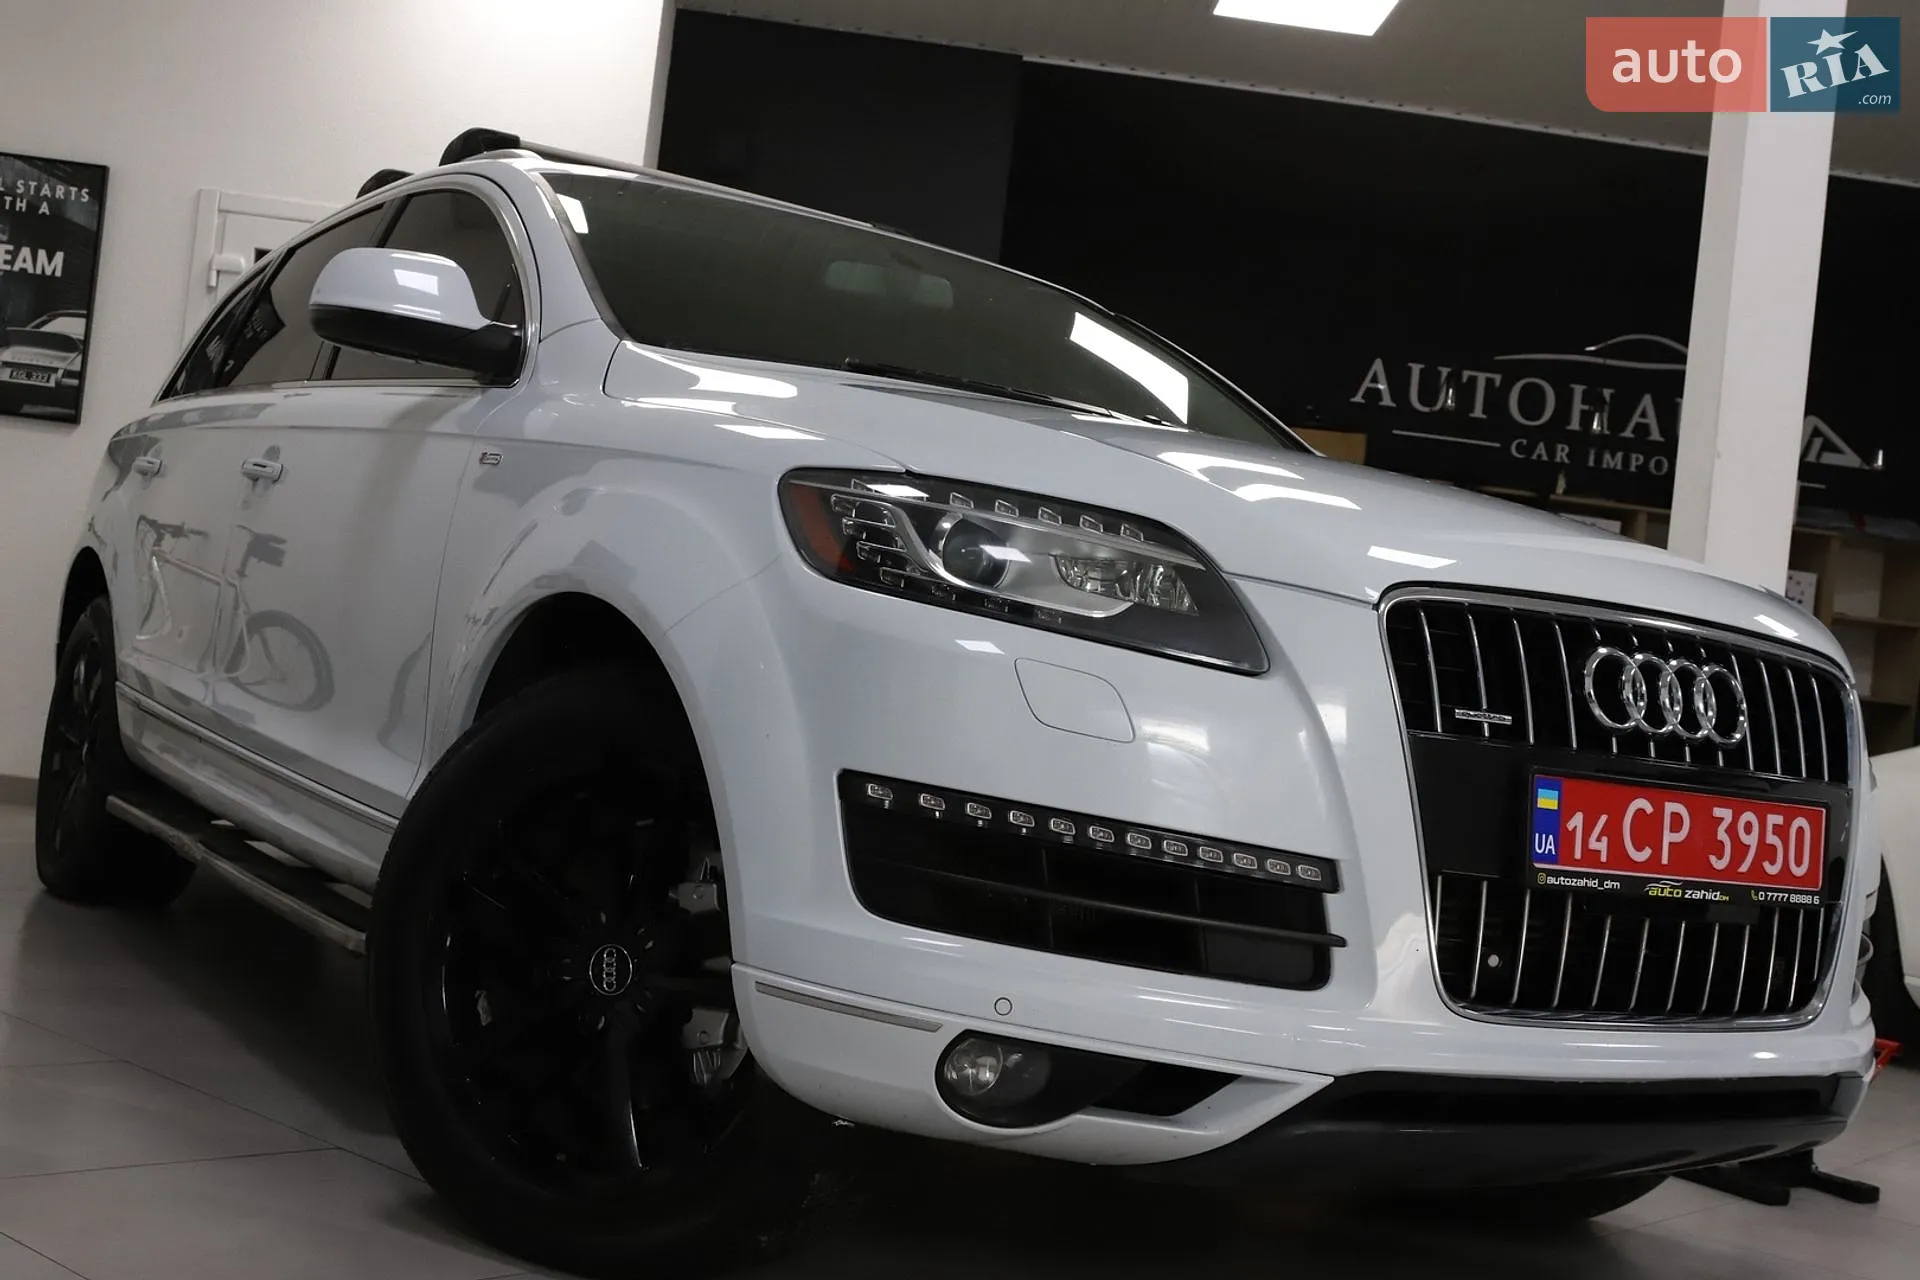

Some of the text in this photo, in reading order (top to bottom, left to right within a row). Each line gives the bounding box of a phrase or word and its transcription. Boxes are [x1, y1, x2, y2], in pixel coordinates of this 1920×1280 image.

[16, 179, 90, 203] STARTS
[38, 201, 50, 215] A
[1350, 357, 1685, 442] AUTOHA
[1511, 439, 1570, 464] CAR
[1534, 832, 1556, 855] UA
[1566, 797, 1811, 877] 14 CP 3950
[1546, 876, 1621, 890] autozahid_dm
[1648, 886, 1682, 898] auto
